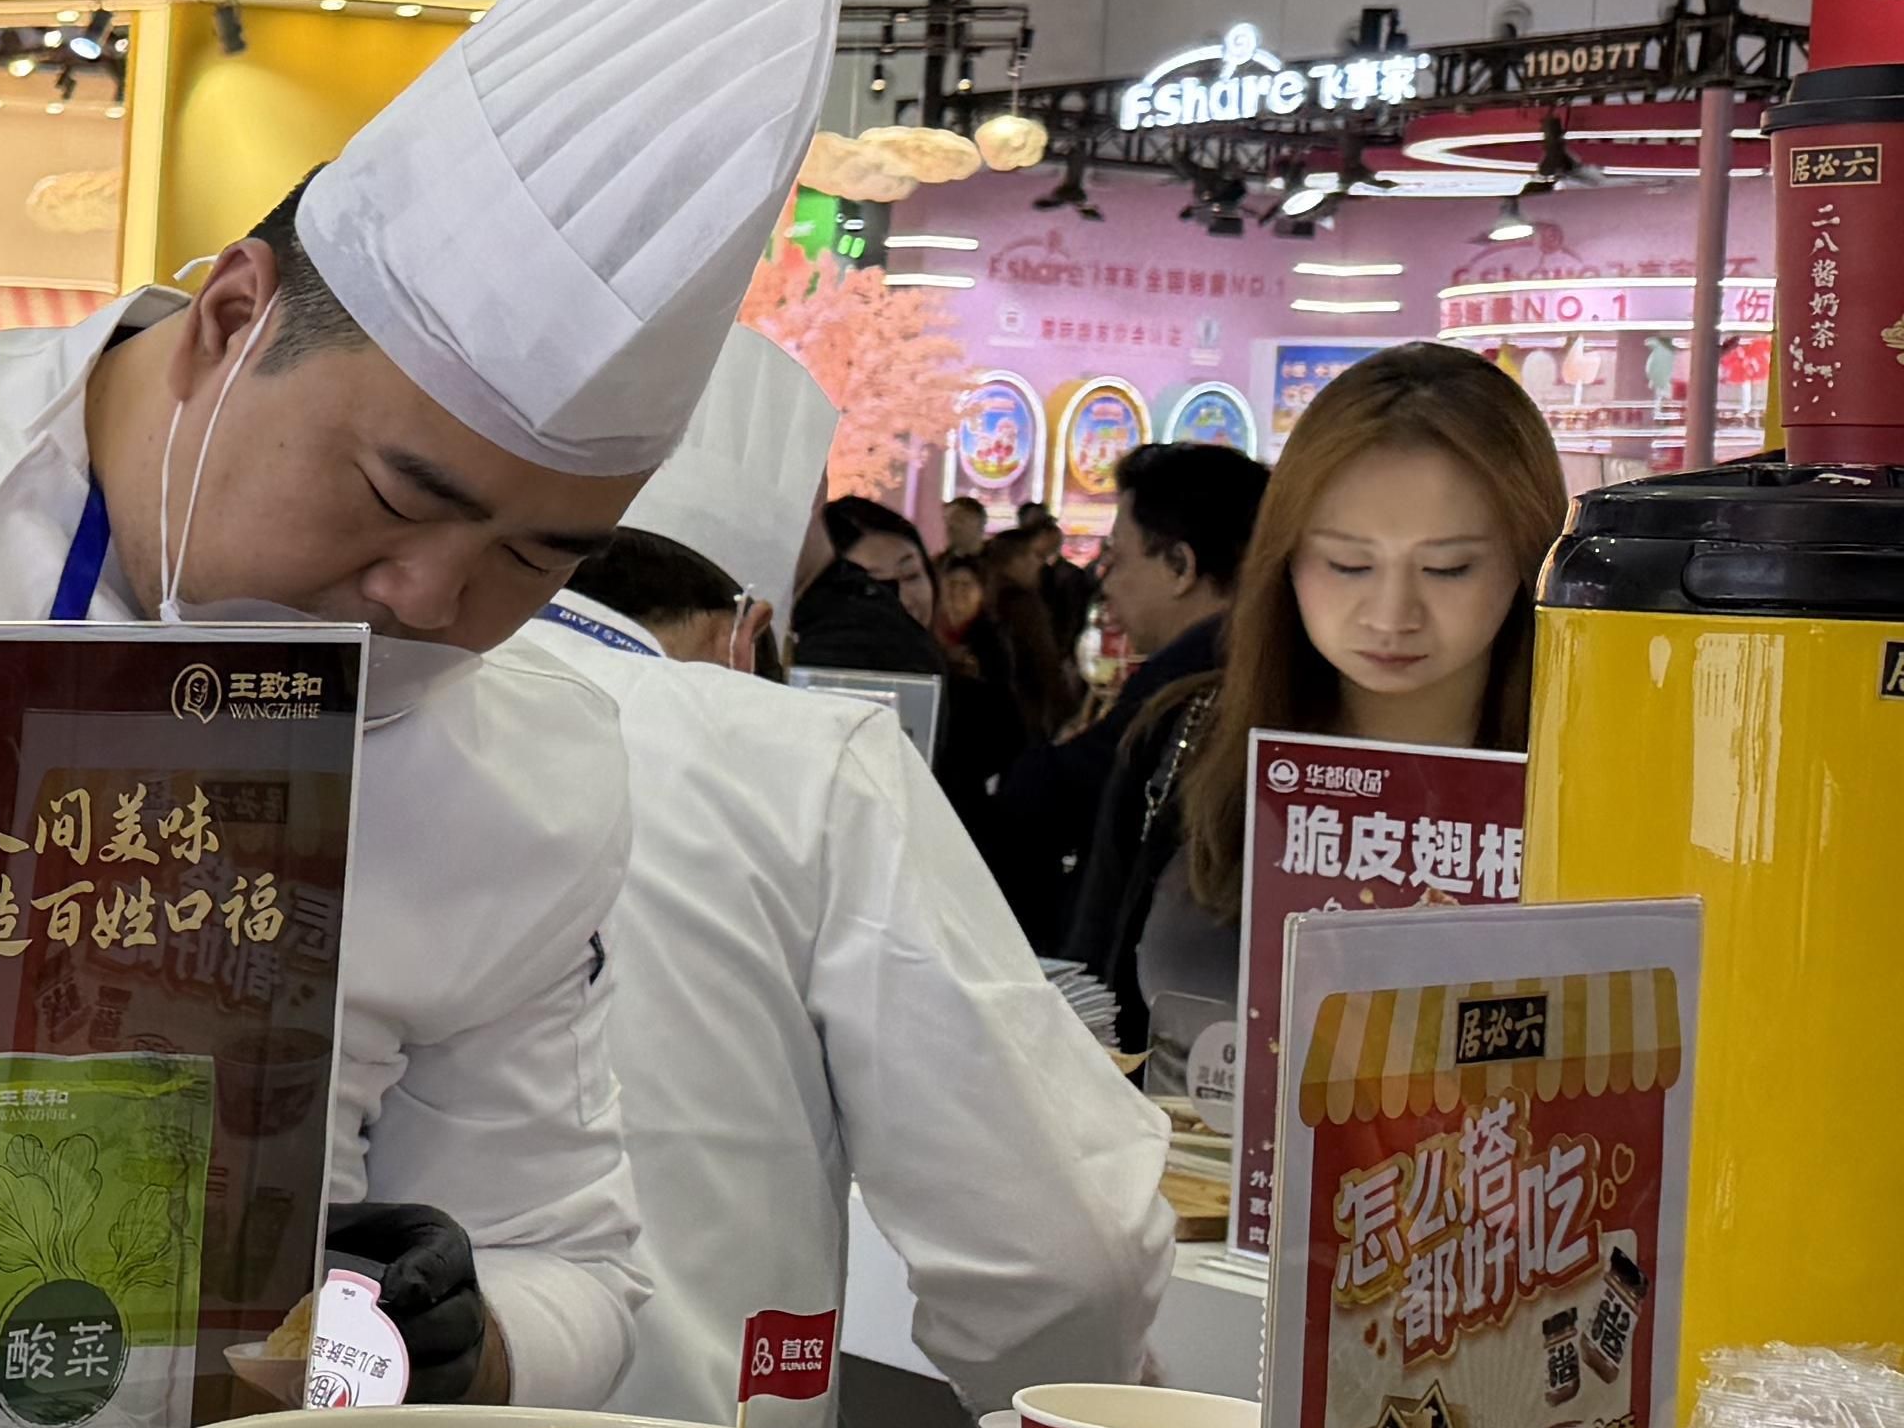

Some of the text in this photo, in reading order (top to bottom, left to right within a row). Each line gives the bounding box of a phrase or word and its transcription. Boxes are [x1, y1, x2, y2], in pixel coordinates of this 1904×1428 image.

[1806, 202, 1840, 350] 二八酱奶茶
[229, 671, 323, 700] 王致和
[229, 702, 322, 721] WANGZHIHE
[1304, 763, 1385, 799] 华都食品
[1281, 804, 1525, 900] 脆皮翅根
[1334, 1096, 1520, 1293] 怎么搭
[1397, 1144, 1601, 1350] 都好吃
[4, 1318, 114, 1382] 酸菜
[781, 1338, 825, 1360] 首农
